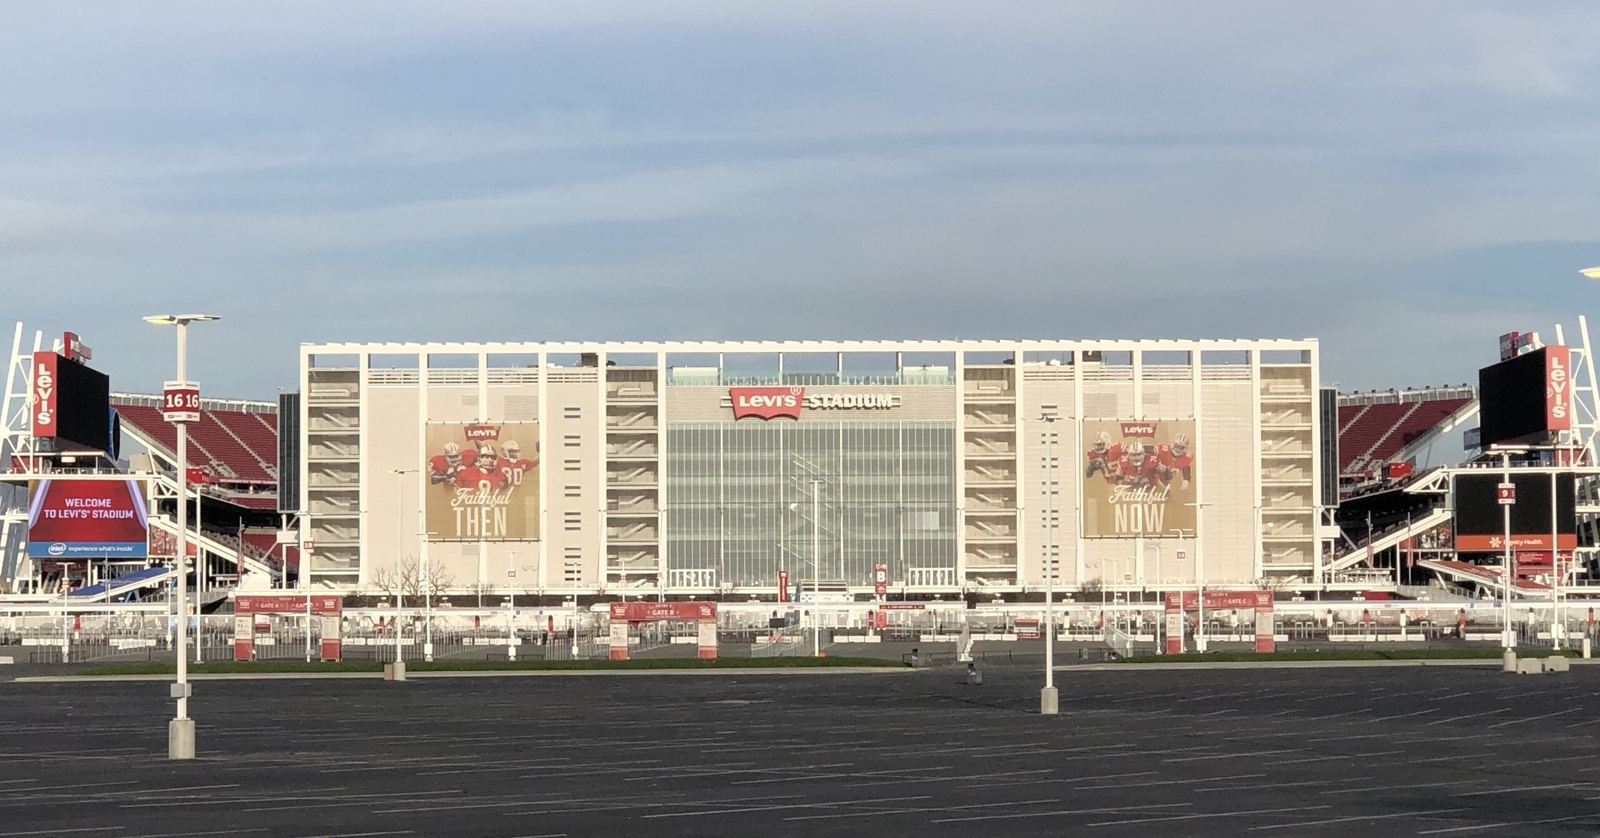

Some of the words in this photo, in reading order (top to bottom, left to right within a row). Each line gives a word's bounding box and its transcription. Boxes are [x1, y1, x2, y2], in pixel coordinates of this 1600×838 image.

[166, 394, 183, 408] 16
[186, 394, 199, 408] 16
[808, 394, 893, 409] STADIUM
[451, 487, 514, 507] Faithful
[1108, 485, 1170, 504] Faithful
[1502, 490, 1508, 498] 9
[65, 498, 112, 508] WELCOME
[44, 509, 56, 518] TO
[92, 510, 134, 519] STADIUM
[1115, 504, 1165, 533] NOW
[453, 507, 507, 537] THEN
[877, 571, 886, 582] B
